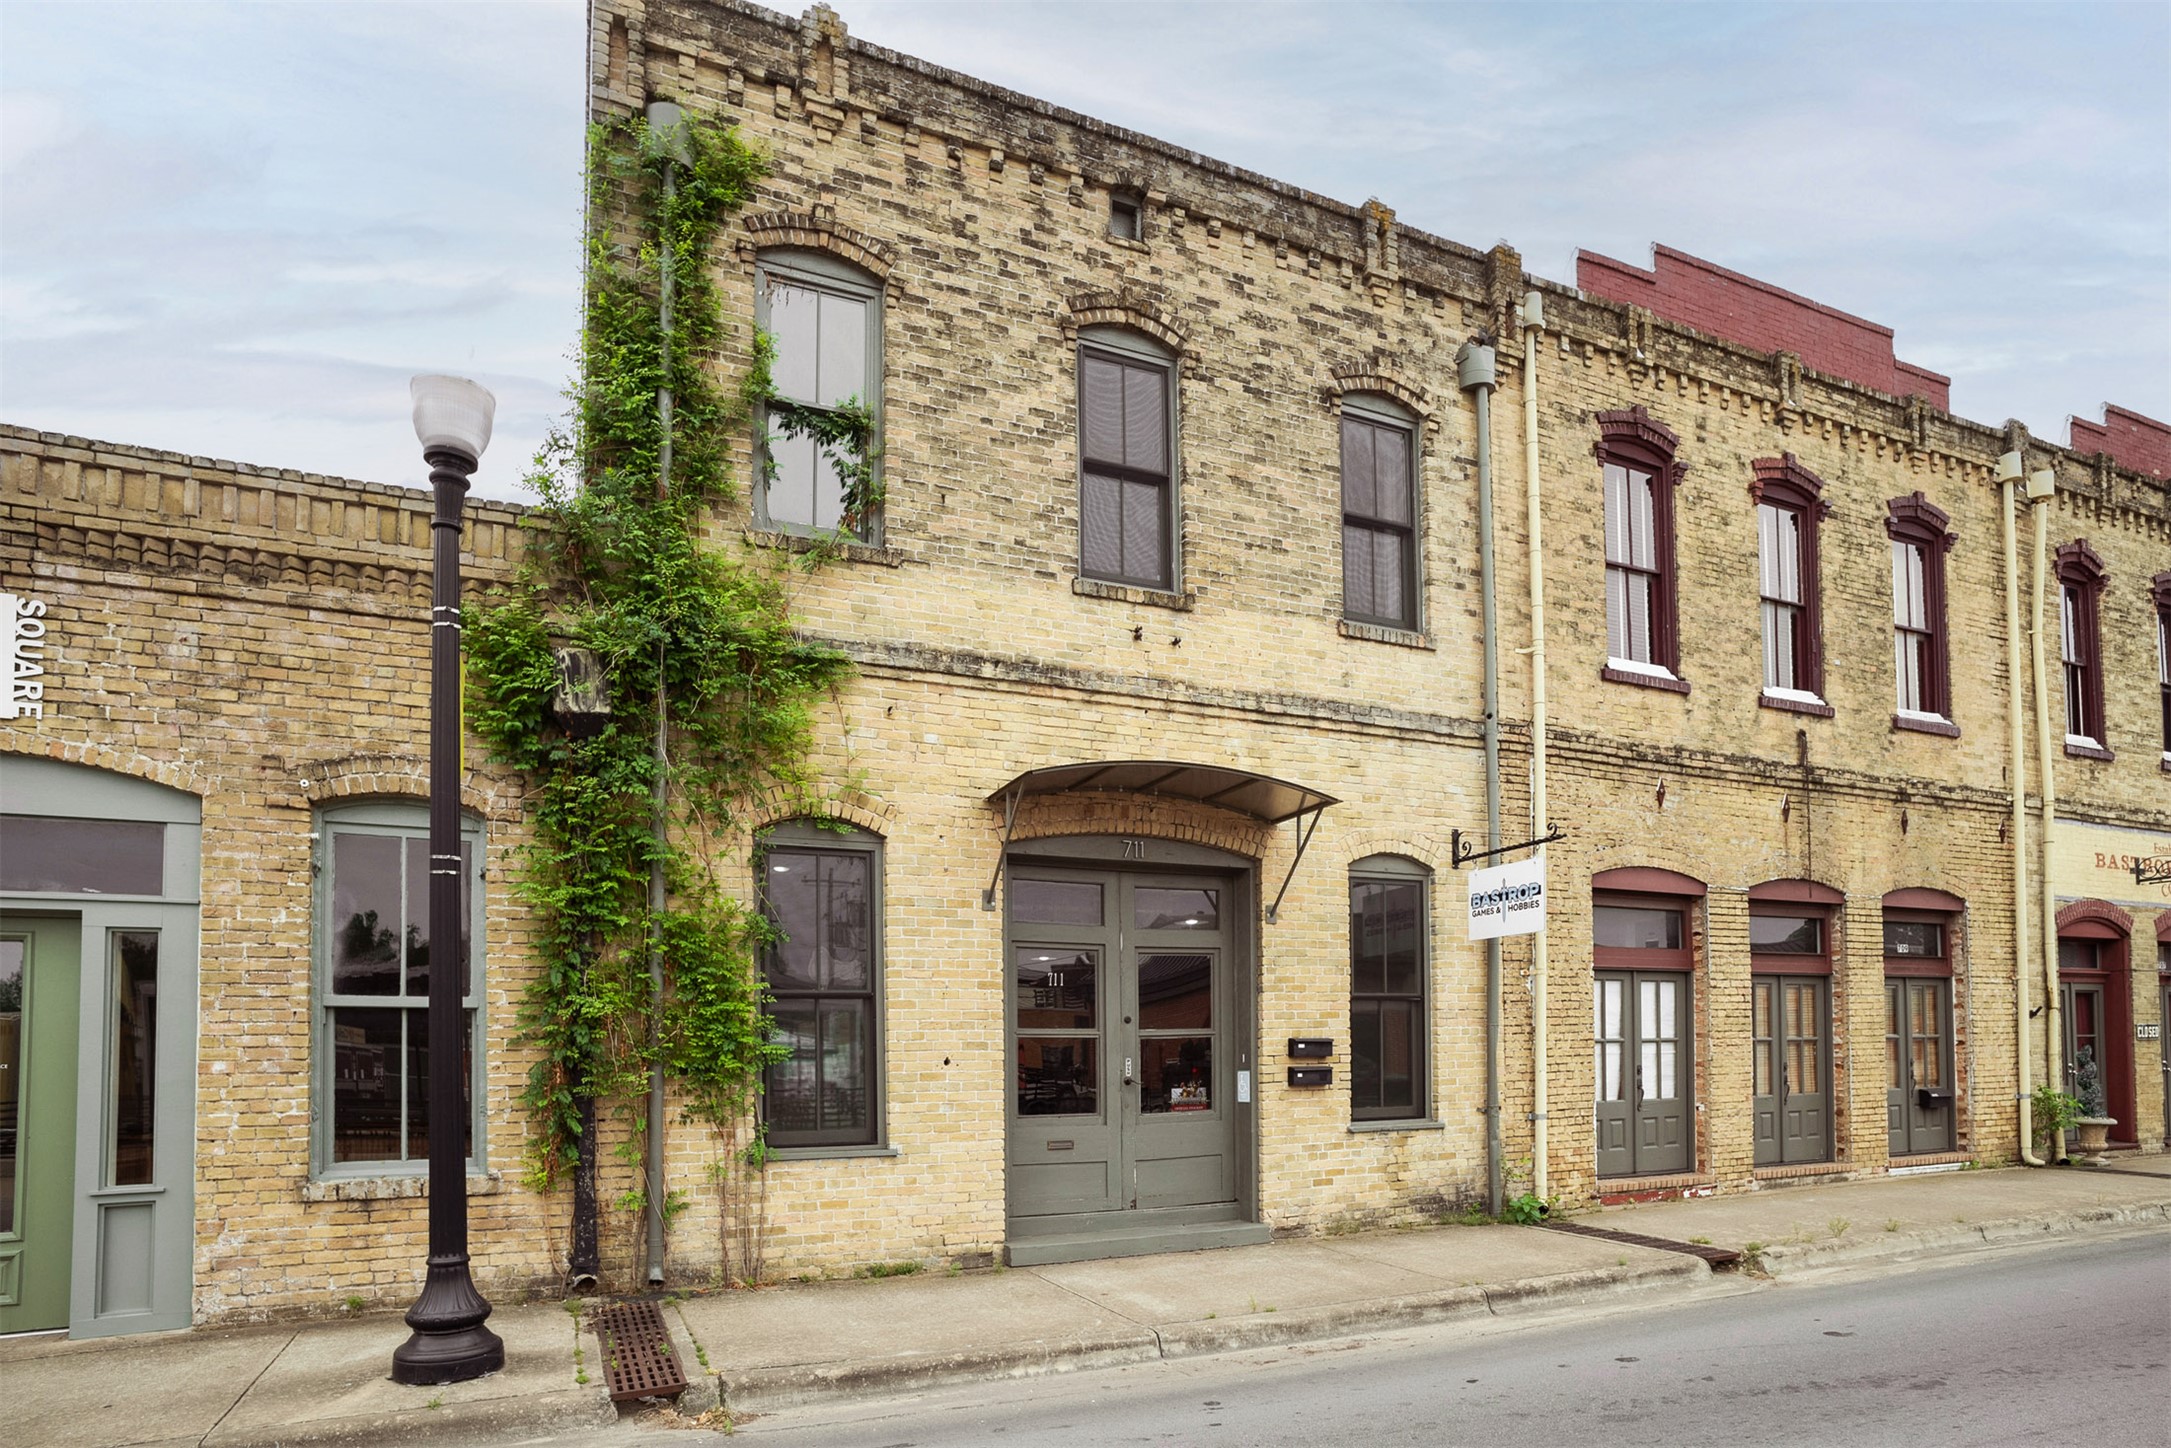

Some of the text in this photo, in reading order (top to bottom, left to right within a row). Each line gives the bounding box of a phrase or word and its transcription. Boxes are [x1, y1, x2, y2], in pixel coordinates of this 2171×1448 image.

[13, 597, 47, 720] SQUARE
[1121, 840, 1145, 858] 711
[1471, 882, 1541, 910] BASTROP
[1472, 907, 1494, 918] GAMES
[1508, 900, 1540, 912] HOBBIES
[1047, 972, 1064, 987] 711
[2137, 1026, 2159, 1038] CLOSED
